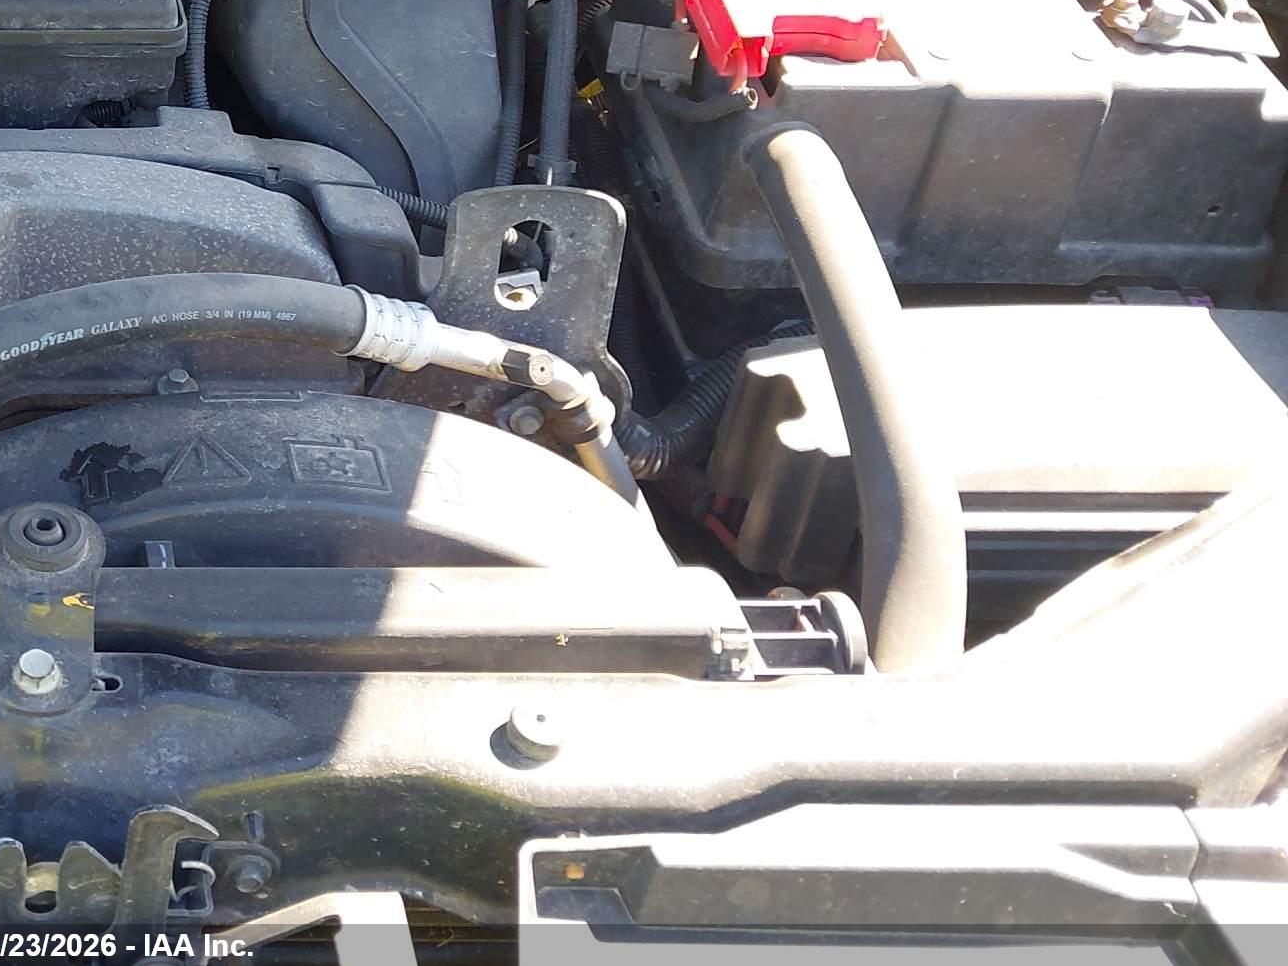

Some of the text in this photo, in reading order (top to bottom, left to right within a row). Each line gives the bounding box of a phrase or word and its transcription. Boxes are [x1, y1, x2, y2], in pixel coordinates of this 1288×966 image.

[0, 329, 84, 361] GOODYEAR
[91, 317, 142, 335] GALAXY
[152, 314, 168, 324] A/C
[172, 311, 200, 321] HOSE
[206, 310, 220, 319] 3/4
[224, 310, 234, 319] IN
